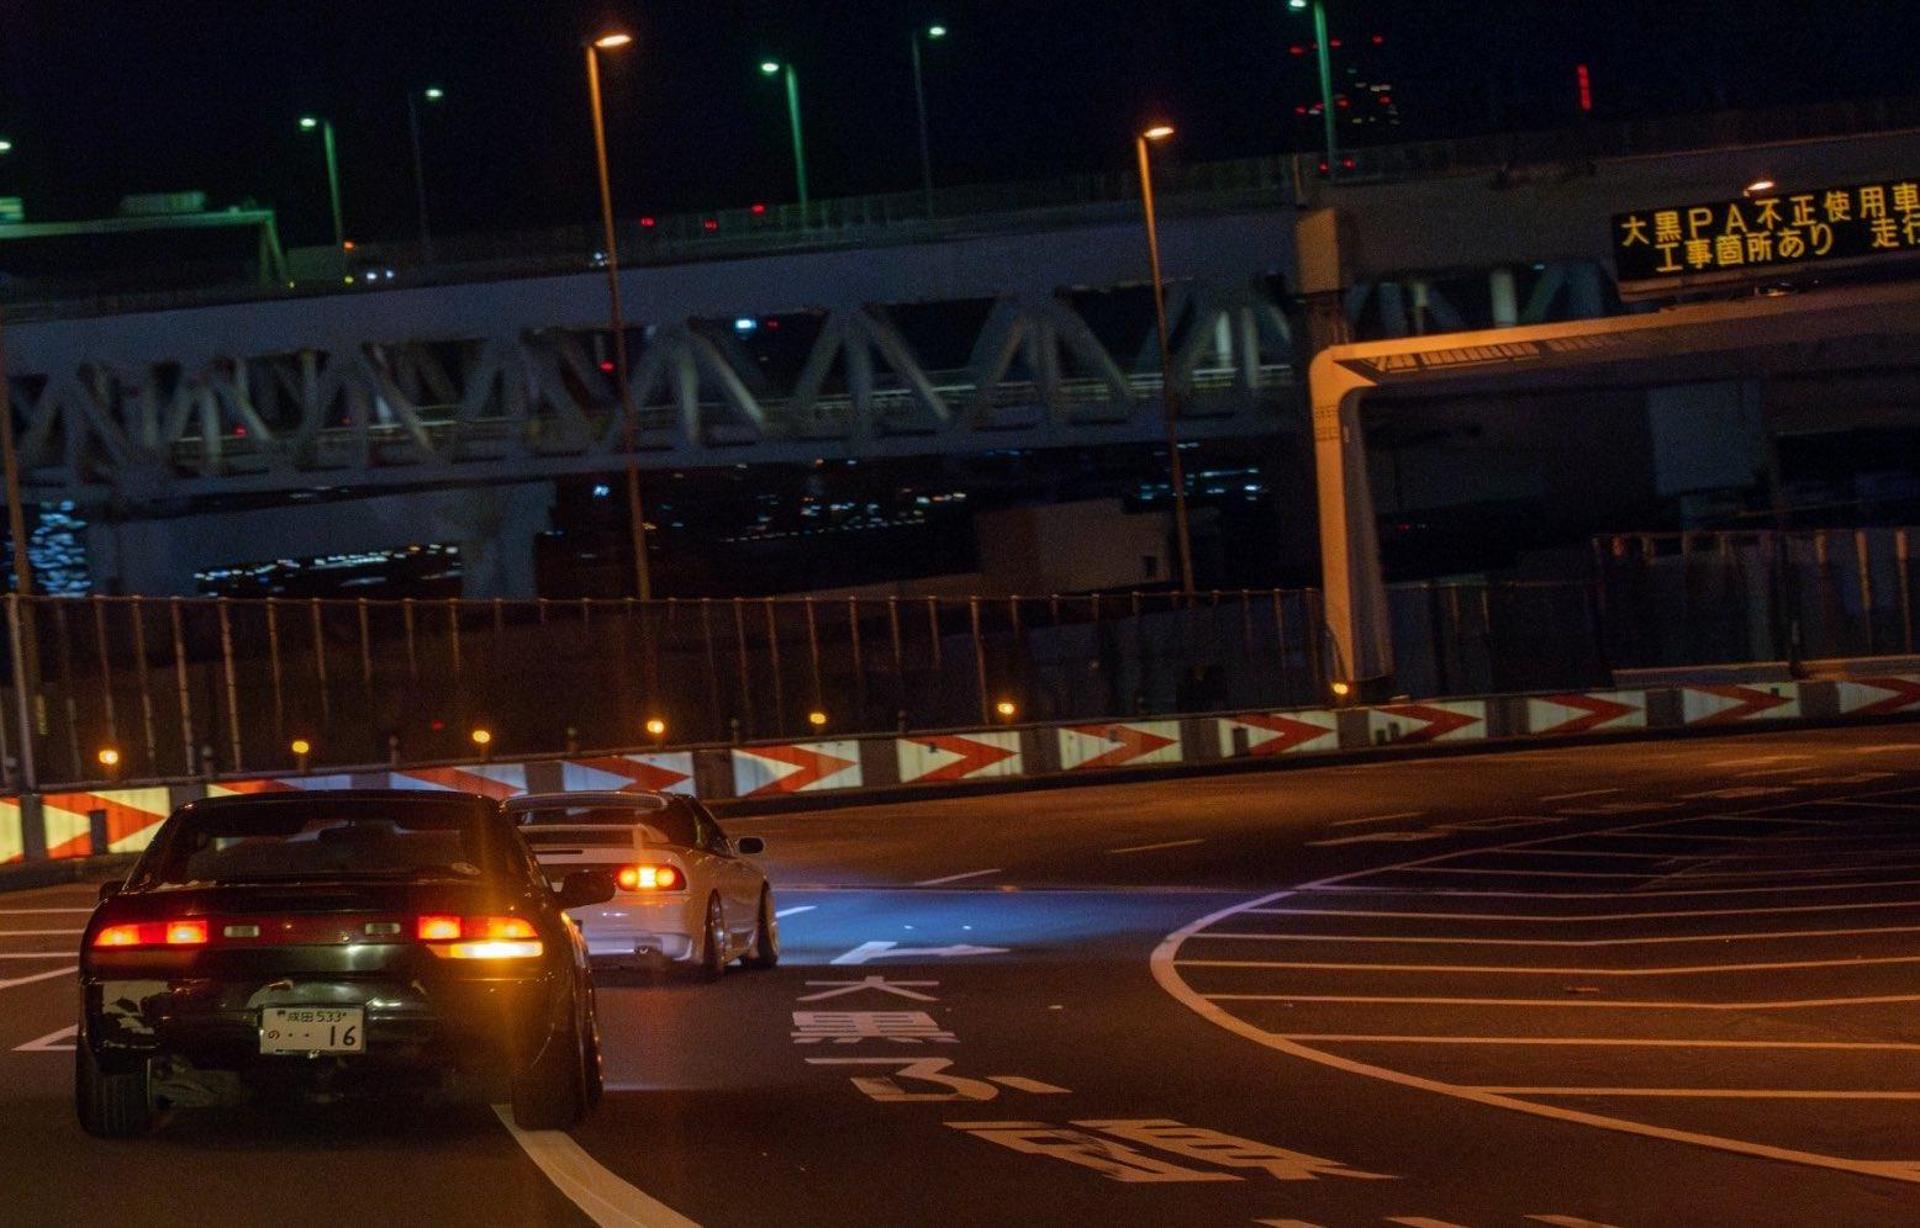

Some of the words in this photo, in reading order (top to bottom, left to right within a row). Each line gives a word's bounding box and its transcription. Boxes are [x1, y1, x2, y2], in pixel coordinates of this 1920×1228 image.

[1655, 223, 1834, 273] 工事箇所あり
